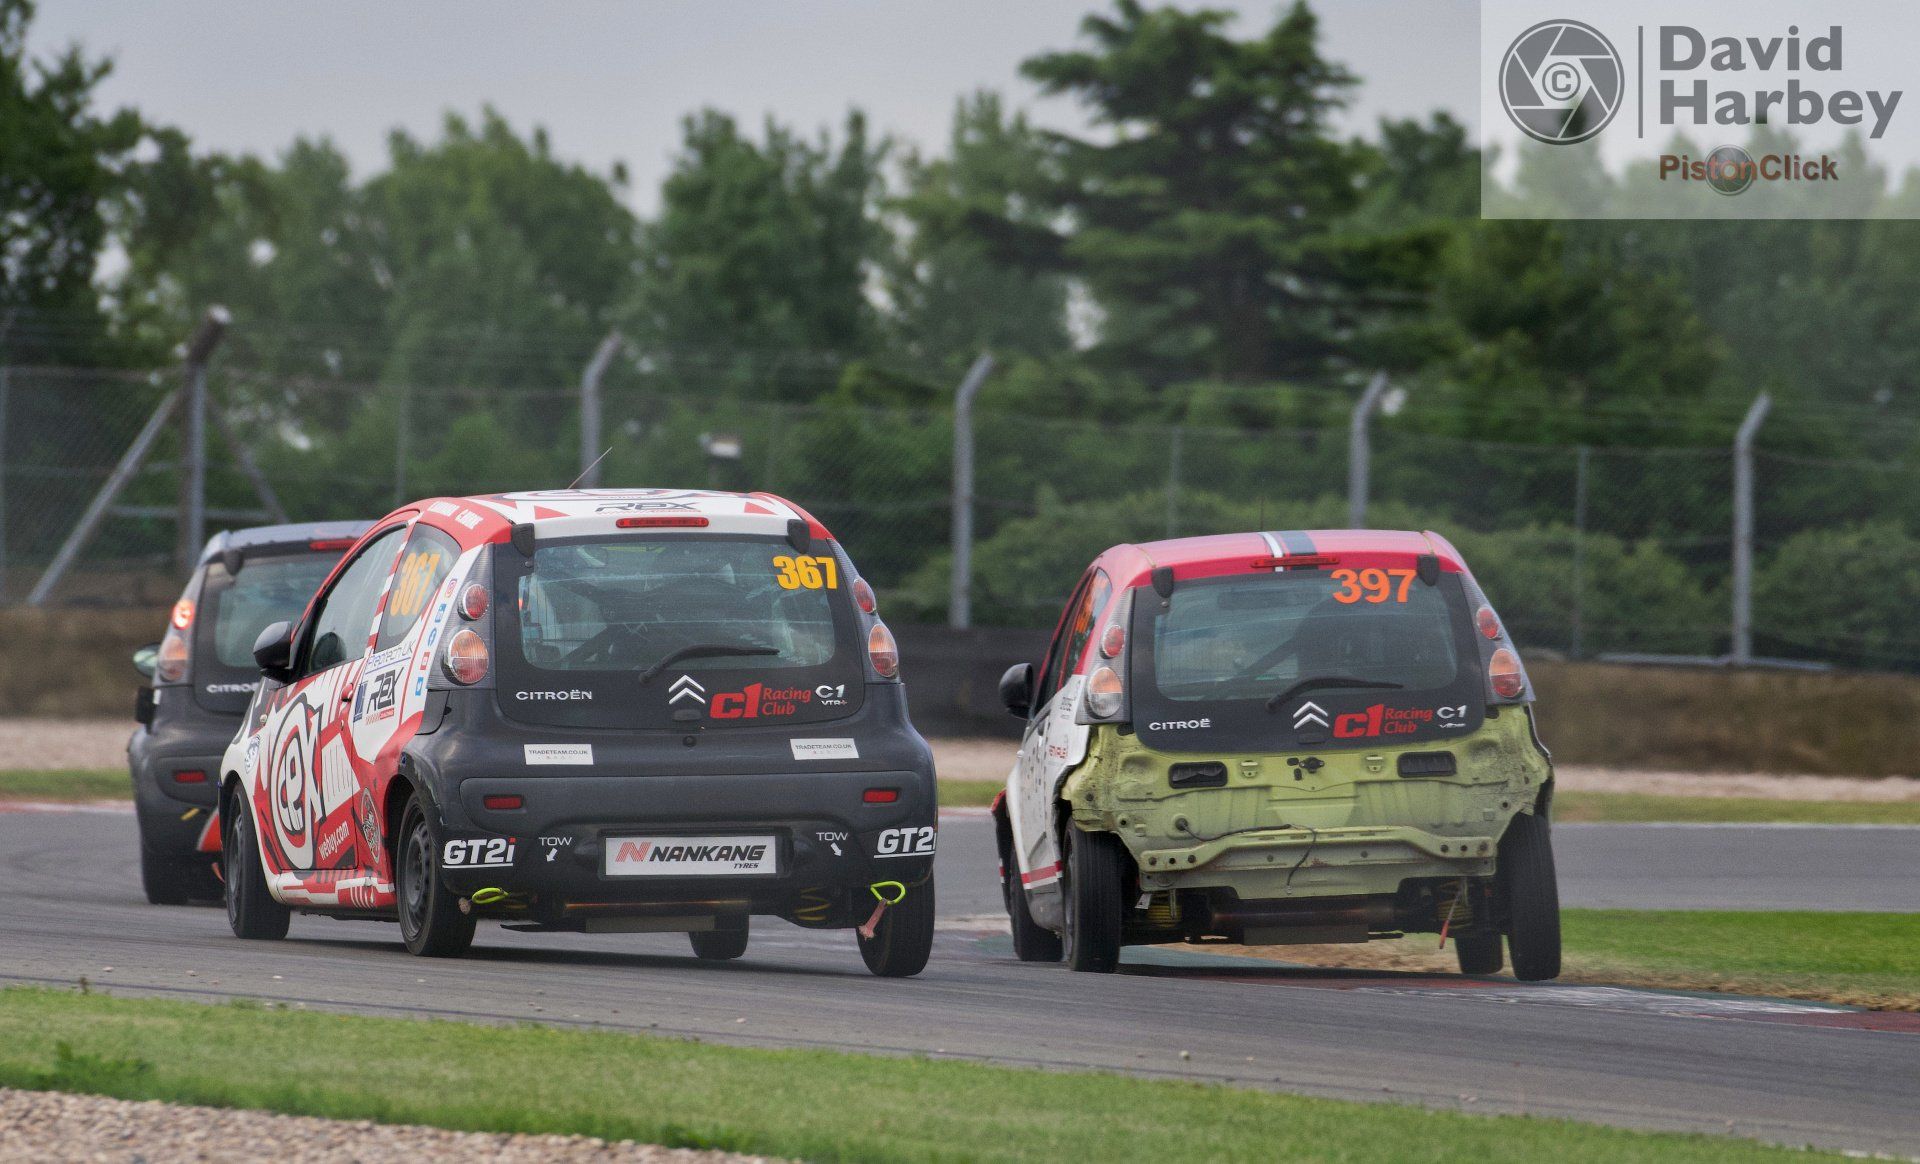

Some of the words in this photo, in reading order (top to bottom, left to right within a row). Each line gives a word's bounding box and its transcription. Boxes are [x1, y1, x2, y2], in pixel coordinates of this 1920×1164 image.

[772, 555, 838, 590] 367
[390, 552, 441, 617] 367
[1330, 568, 1418, 605] 397
[515, 688, 593, 701] CITROËN
[763, 686, 812, 704] Racing
[815, 684, 846, 699] C1
[762, 702, 796, 716] Club
[1384, 706, 1433, 721] Racing
[1436, 705, 1467, 719] C1
[1149, 717, 1211, 731] CITROË
[1384, 720, 1417, 735] Club
[318, 820, 350, 861] webuy.com
[538, 836, 573, 847] TOW
[815, 831, 849, 842] TOW
[443, 837, 517, 865] GT2i
[649, 844, 767, 863] NANKANG
[733, 862, 760, 870] TYRES
